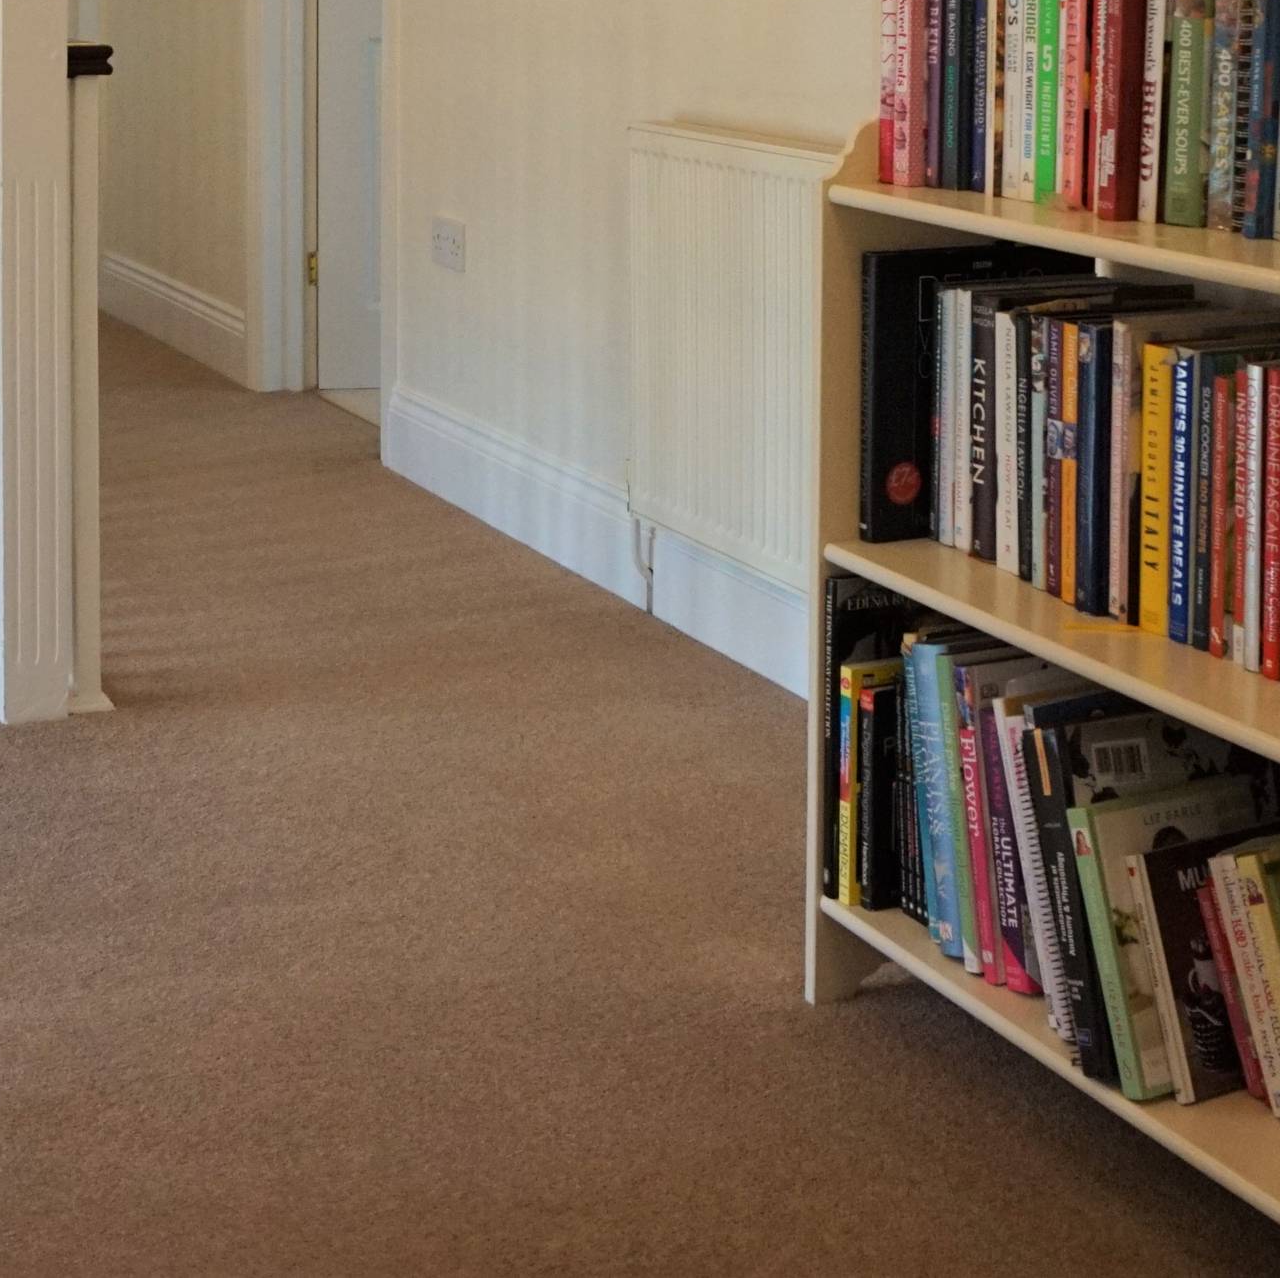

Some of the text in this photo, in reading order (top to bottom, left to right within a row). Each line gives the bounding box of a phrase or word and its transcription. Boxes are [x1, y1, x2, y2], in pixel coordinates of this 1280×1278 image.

[896, 47, 908, 87] Treats
[928, 6, 940, 65] BAKING
[946, 65, 956, 93] GINO
[947, 12, 958, 57] BAKING
[1023, 50, 1036, 159] LOSE WEIGHT FOR GOOD
[1039, 43, 1053, 157] 5 INGREDIENTS
[1063, 73, 1079, 157] EXPRESS
[1139, 78, 1159, 182] BREAD
[1173, 19, 1191, 177] 400 BEST-EVER SOUPS
[1214, 49, 1233, 168] 400 SAUCES
[1049, 323, 1060, 415] JAMIE OLIVER
[1066, 377, 1078, 420] Oliver
[971, 357, 987, 485] KITCHEN
[1004, 326, 1013, 530] NIGELLA LAWSON HOW TO EAT
[1017, 377, 1028, 501] NIGELLA LAWSON
[1144, 364, 1160, 572] JAMIE ITALY
[1200, 386, 1212, 477] SLOW COOKER
[1233, 391, 1246, 519] INSPIRALIZED
[1266, 384, 1280, 553] LORRAINE PASCALE
[1172, 435, 1187, 537] 30-MINUTE
[846, 594, 888, 612] EDINA
[1172, 540, 1184, 606] MEALS
[862, 730, 872, 768] Digital
[959, 735, 983, 838] Flower
[1143, 812, 1161, 826] LIZ
[990, 816, 1009, 927] FLORAL COLLECTION
[998, 817, 1019, 928] the ULTIMATE
[1177, 865, 1211, 894] MU
[1258, 1025, 1277, 1079] recipes
